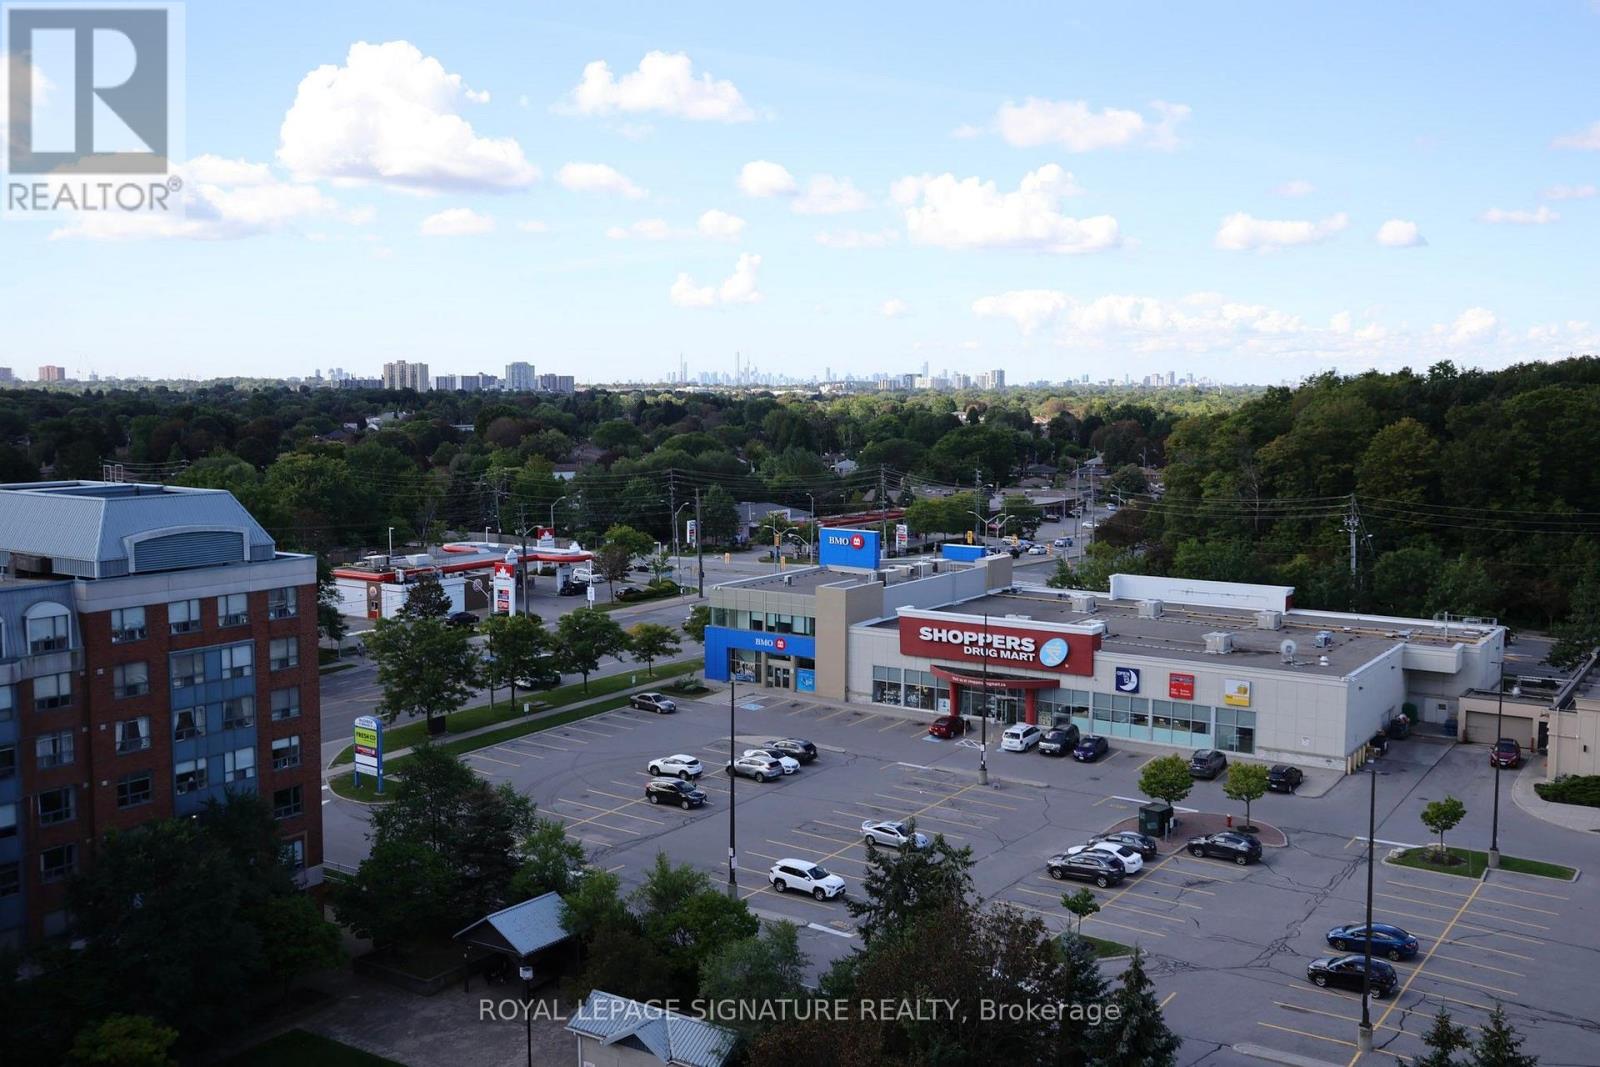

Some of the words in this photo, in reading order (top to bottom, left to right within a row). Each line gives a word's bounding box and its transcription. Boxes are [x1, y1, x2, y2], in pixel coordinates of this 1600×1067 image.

[828, 536, 849, 545] BMO
[755, 638, 773, 647] BMO
[919, 626, 1036, 652] SHOPPERS
[963, 645, 998, 658] DRUG
[1000, 649, 1035, 662] MART
